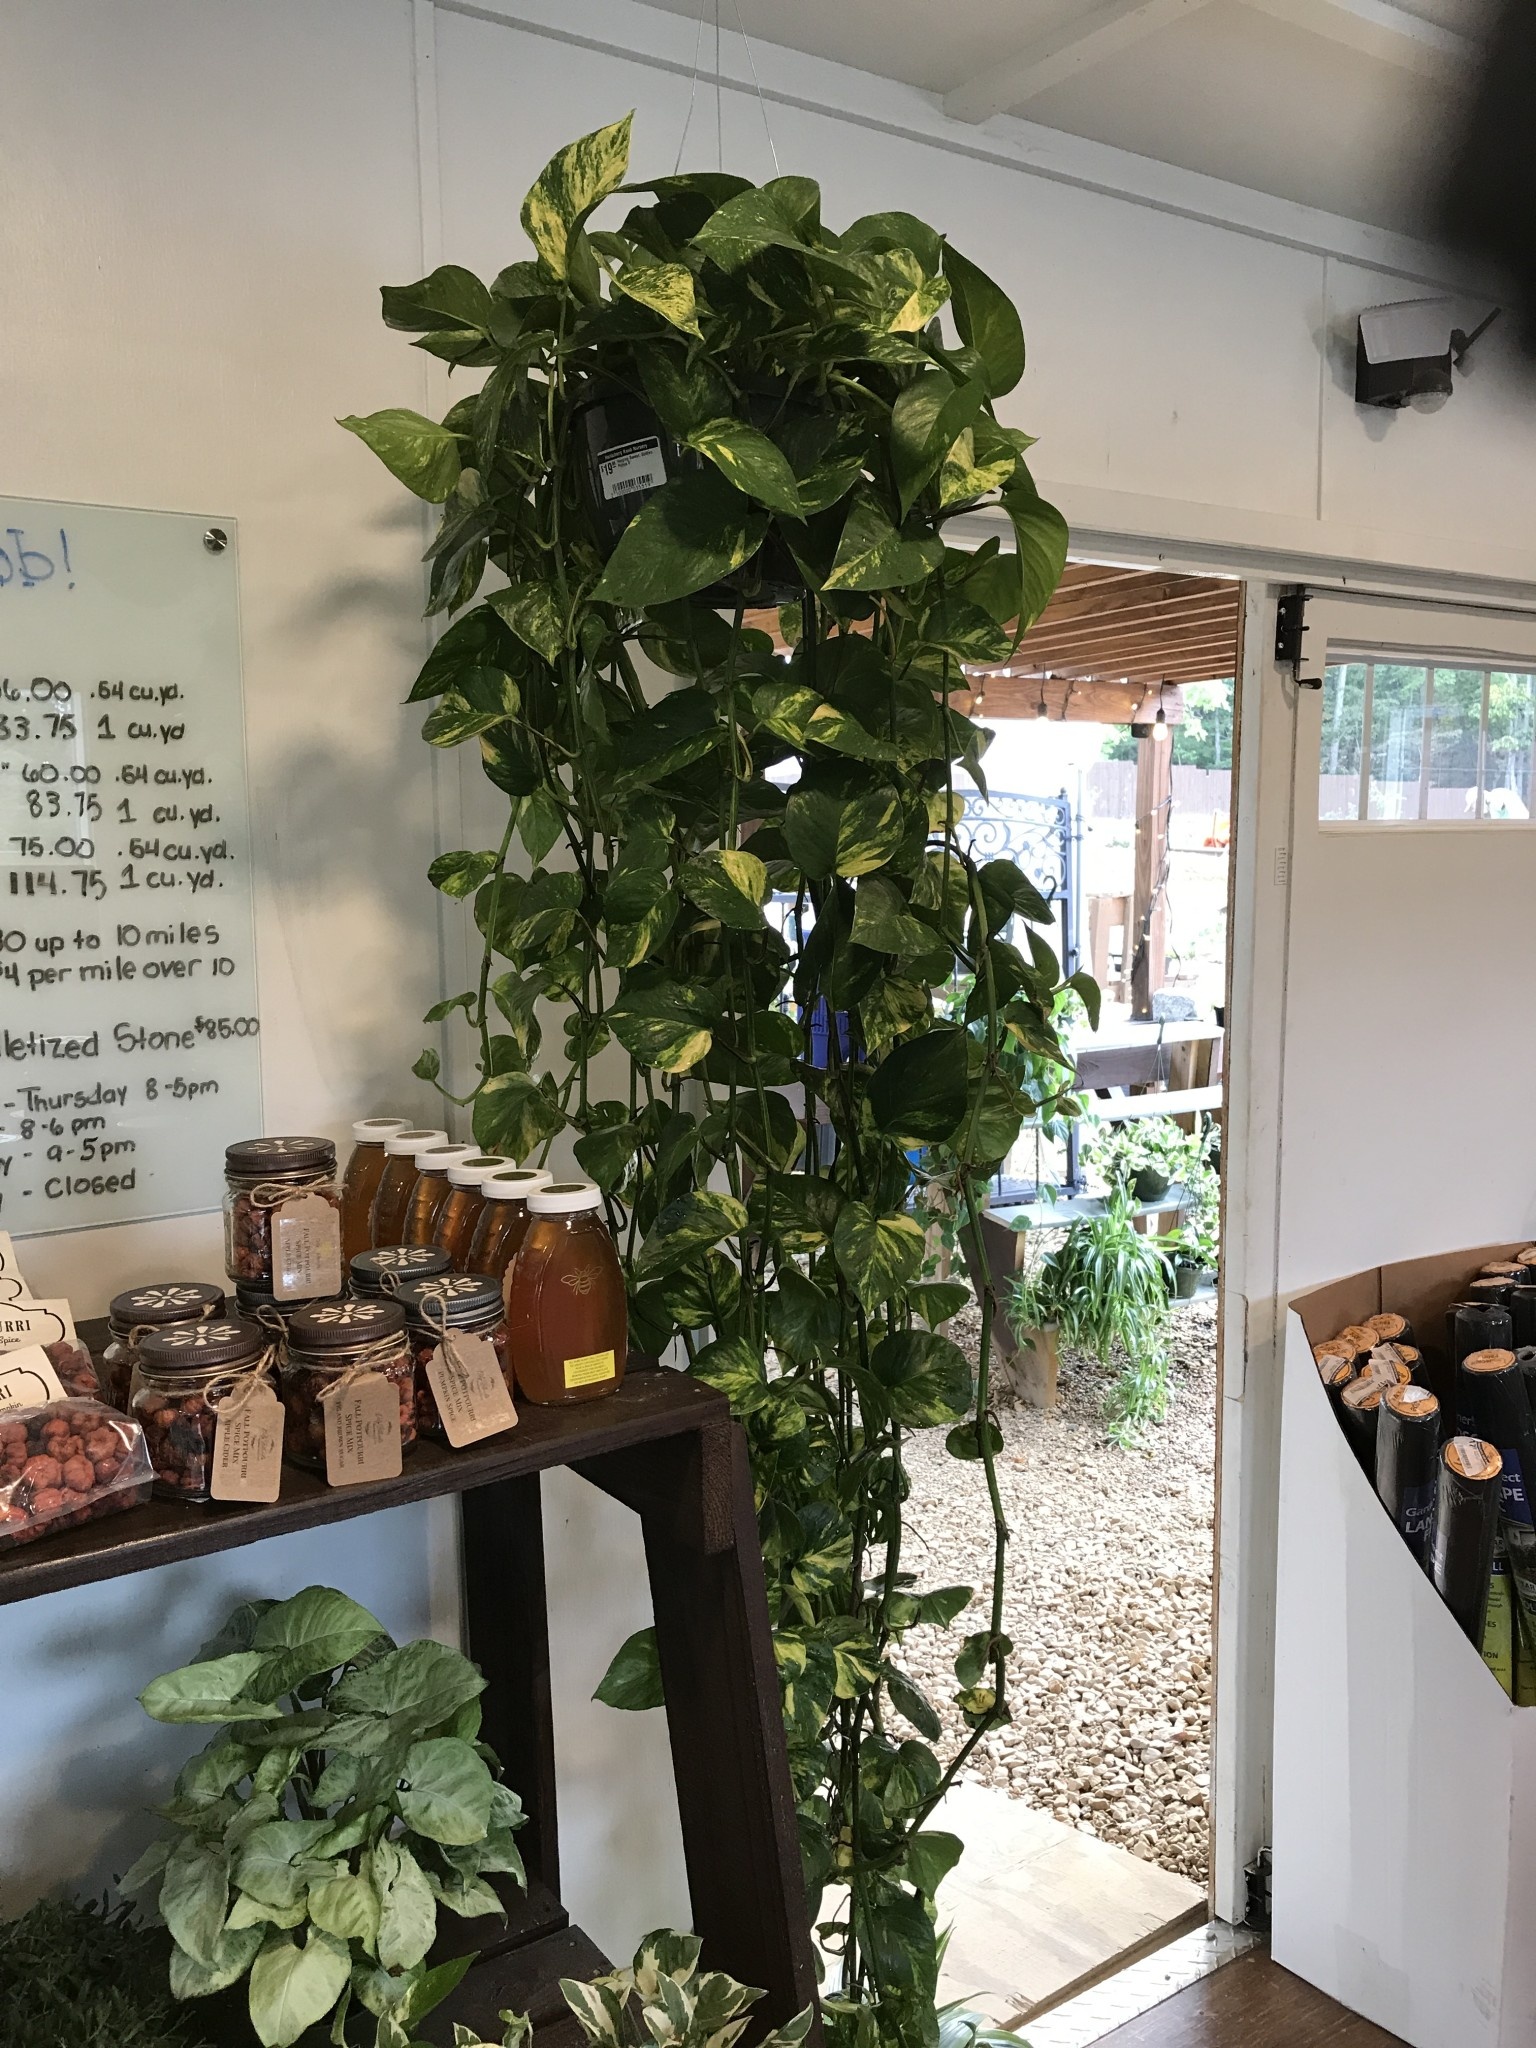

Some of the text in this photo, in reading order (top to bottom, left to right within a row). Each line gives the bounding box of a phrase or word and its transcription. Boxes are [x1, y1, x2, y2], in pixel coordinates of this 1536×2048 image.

[0, 677, 72, 702] 6.00
[98, 713, 116, 739] 1
[26, 788, 102, 822] 83.75
[117, 798, 137, 823] 1
[9, 836, 95, 859] 75.00
[10, 869, 107, 900] 114.75
[120, 863, 140, 889] 1
[35, 935, 64, 957] up
[73, 930, 100, 950] to
[117, 924, 141, 946] 10
[146, 922, 220, 945] miles
[27, 967, 72, 991] per
[79, 955, 136, 982] mile
[142, 959, 202, 979] over
[212, 957, 235, 976] 10
[0, 1029, 99, 1061] letized
[113, 1022, 194, 1052] Stone
[17, 1081, 127, 1112] Thursday
[45, 1167, 135, 1199] Closed
